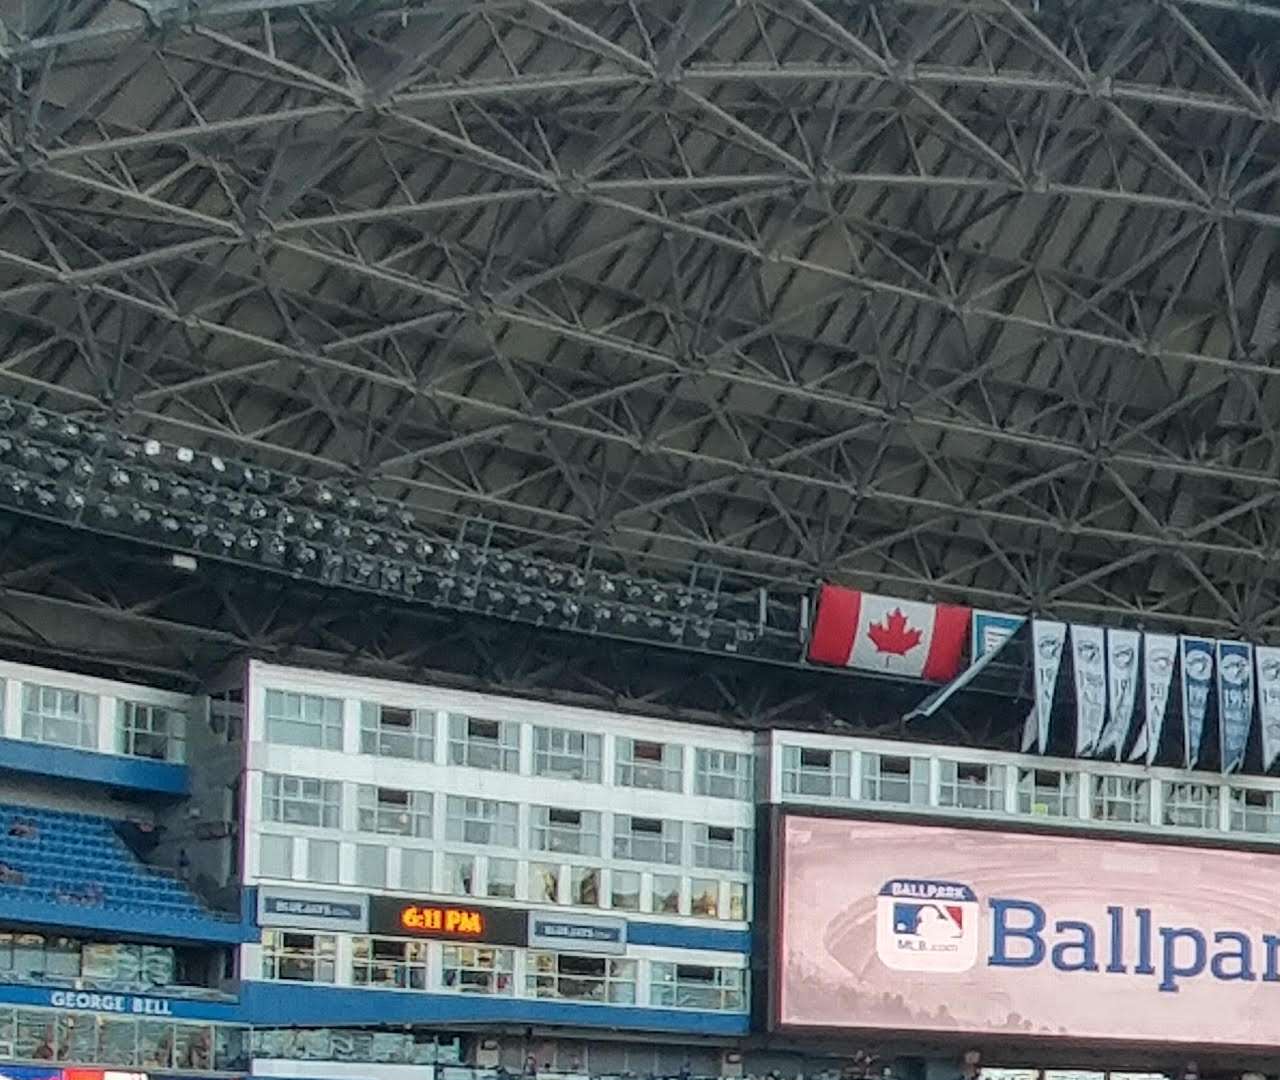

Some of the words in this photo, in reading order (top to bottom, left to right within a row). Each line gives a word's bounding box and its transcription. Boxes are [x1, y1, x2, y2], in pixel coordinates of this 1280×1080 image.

[892, 882, 966, 900] BALLPARK
[402, 906, 441, 931] 6:11
[445, 909, 484, 934] PM
[51, 990, 125, 1012] GEORGE
[131, 994, 173, 1015] BELL
